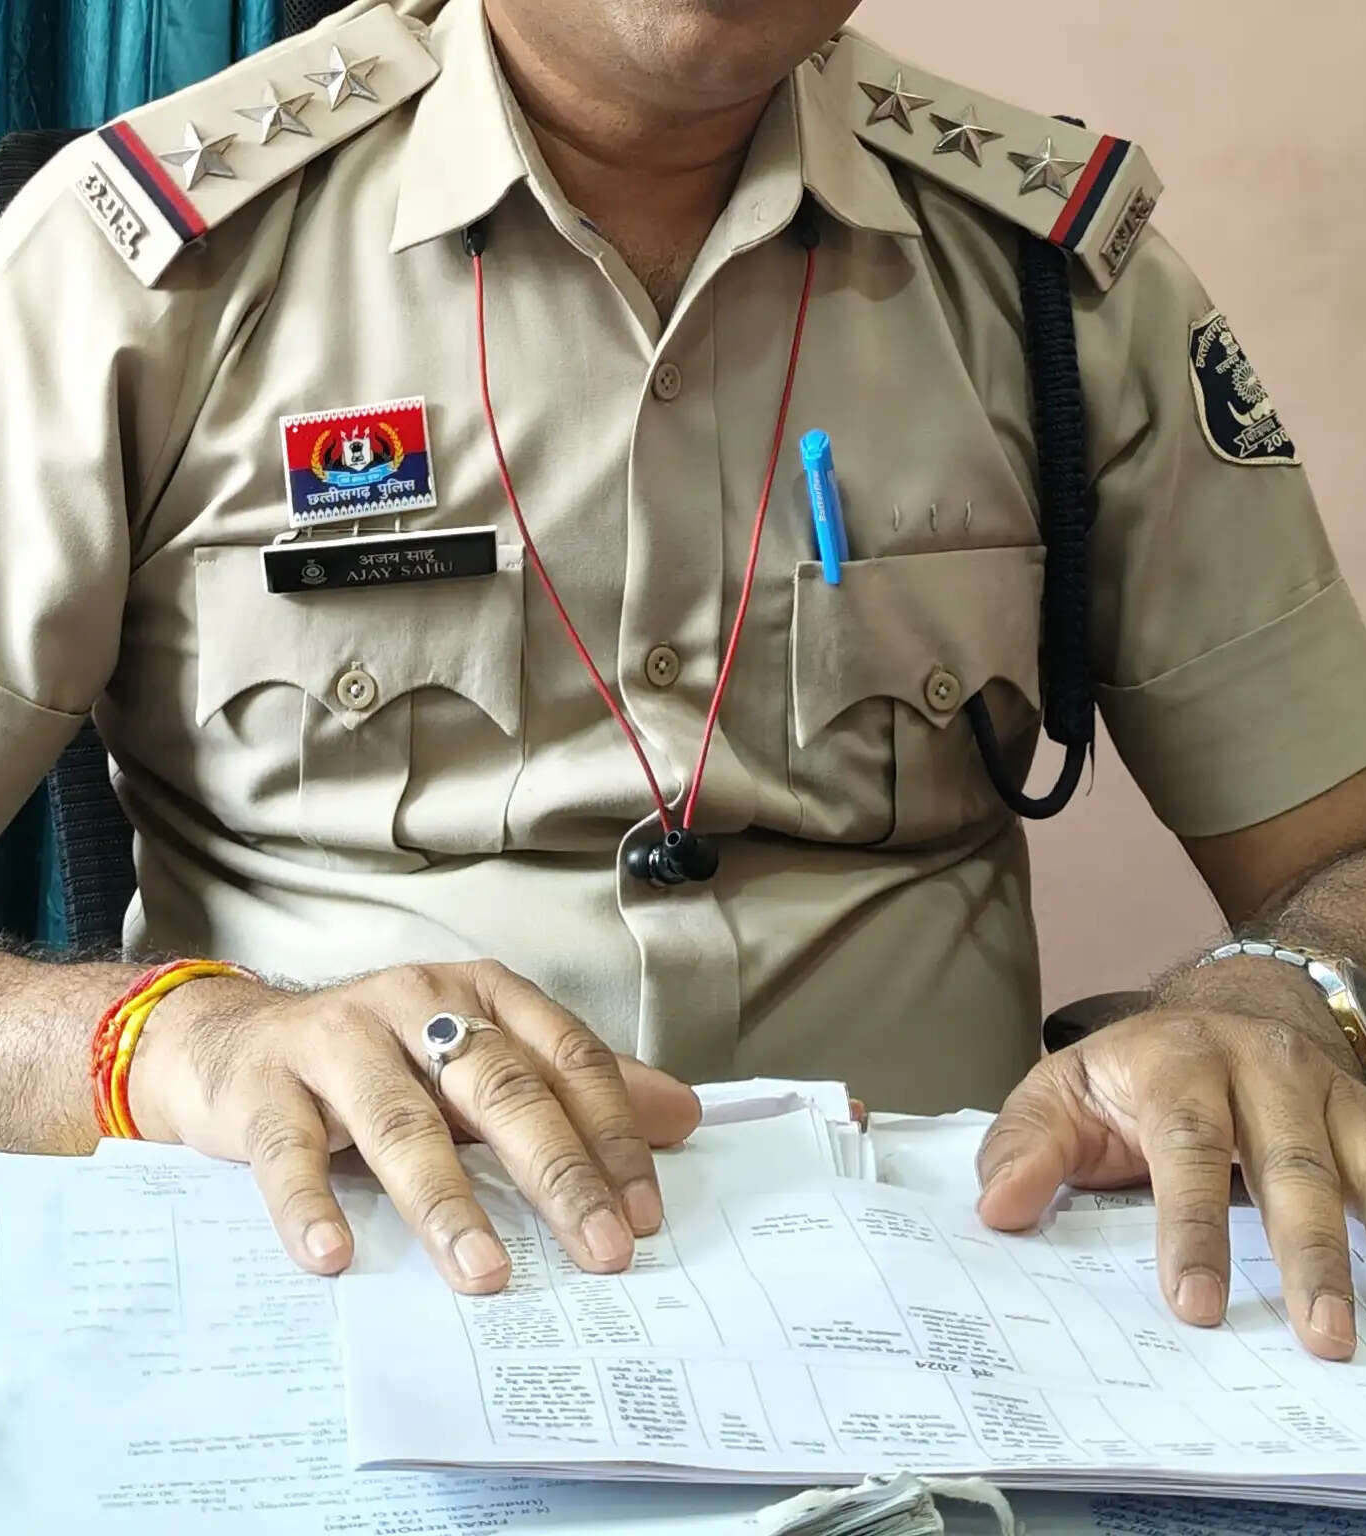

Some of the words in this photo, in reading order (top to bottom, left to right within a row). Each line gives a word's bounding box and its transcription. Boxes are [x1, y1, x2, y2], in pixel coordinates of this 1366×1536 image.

[306, 484, 372, 506] छत्तीसगढ़
[378, 478, 416, 500] पुलिस
[358, 551, 399, 567] अजय
[404, 549, 436, 565] साहू
[346, 567, 393, 582] AJAY
[400, 561, 453, 581] SAHU
[374, 1523, 449, 1536] REPORT
[454, 1518, 509, 1530] FINAL
